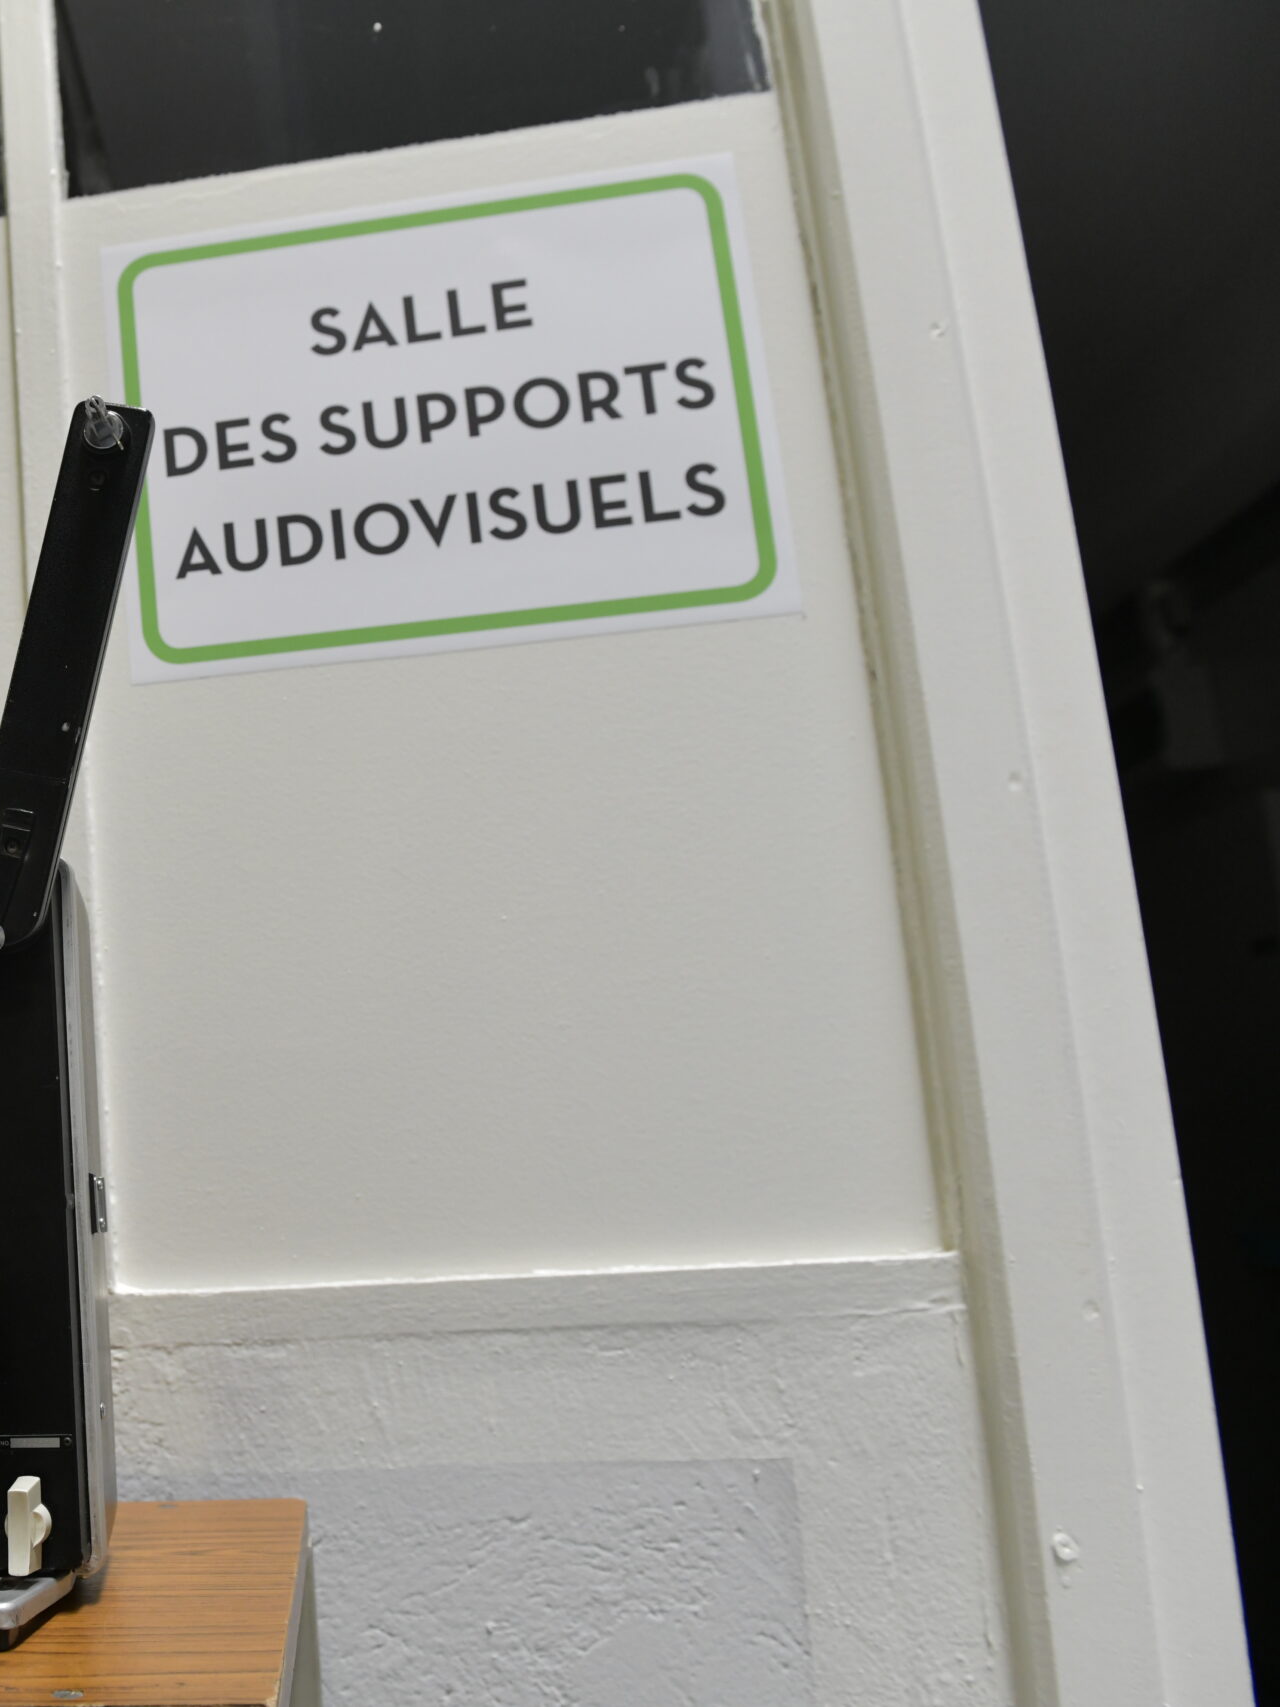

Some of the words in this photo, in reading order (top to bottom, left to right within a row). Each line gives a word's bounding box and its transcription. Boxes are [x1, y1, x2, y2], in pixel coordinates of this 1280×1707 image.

[310, 279, 534, 356] SALLE
[163, 412, 298, 478] DES
[318, 357, 717, 456] SUPPORTS
[175, 462, 727, 580] AUDIOVISUELS
